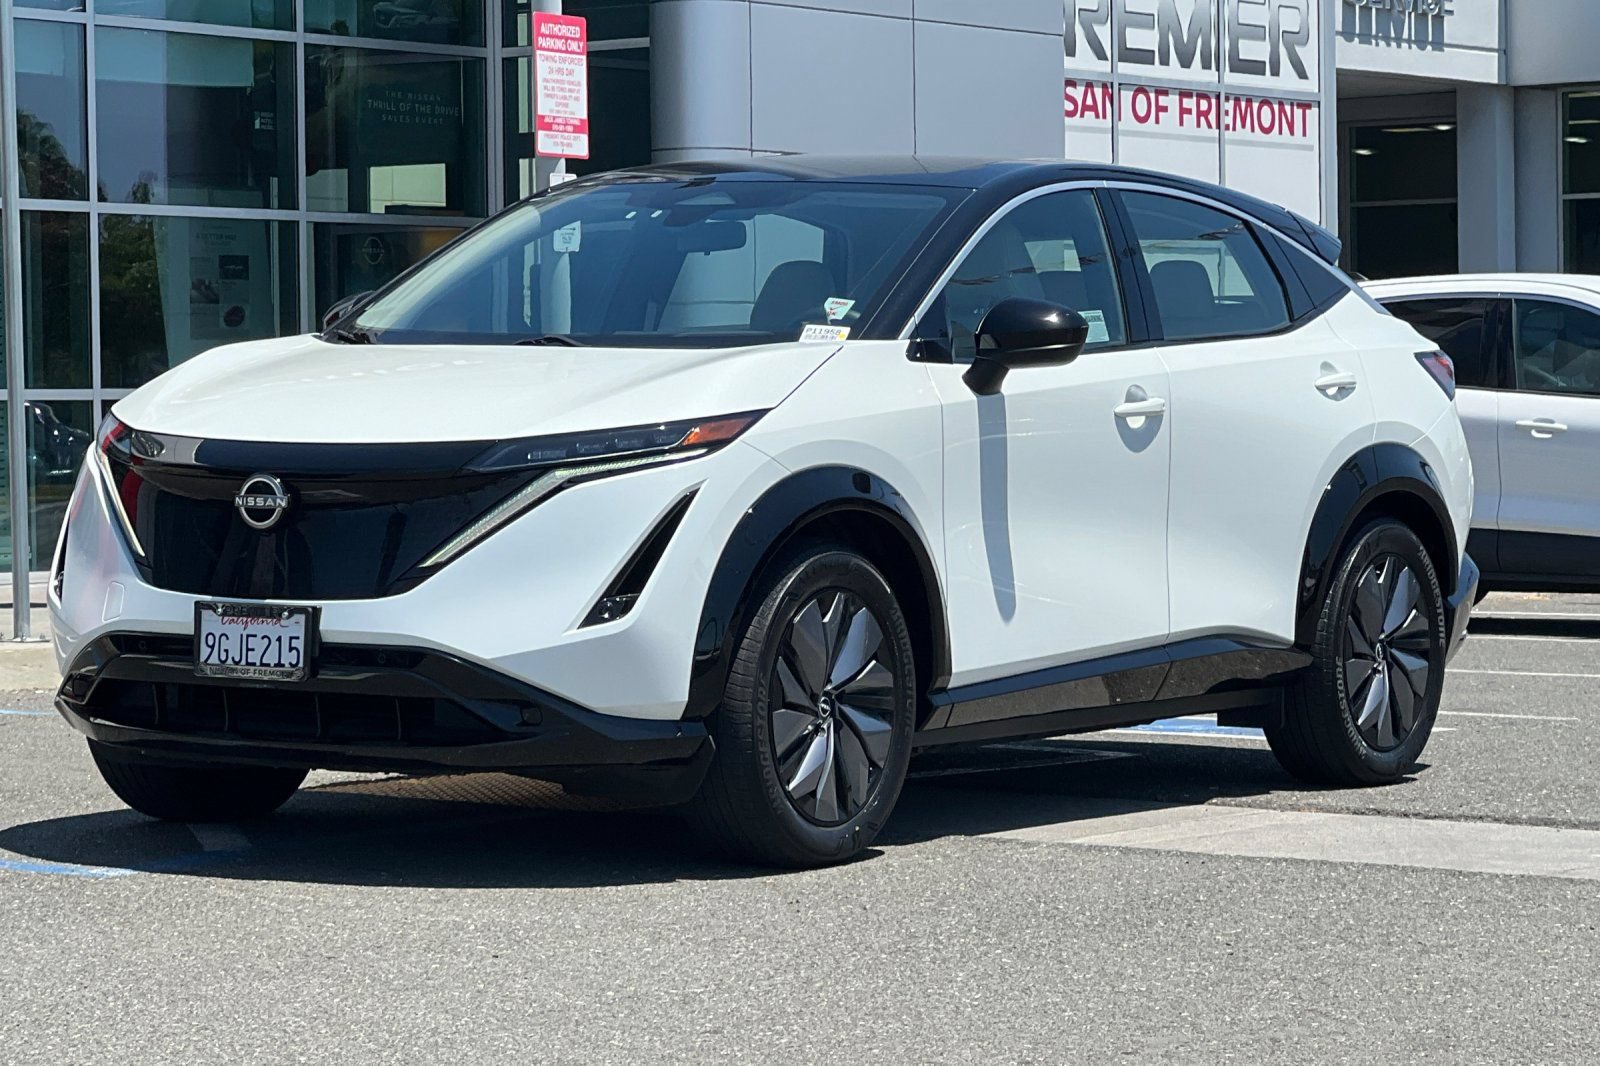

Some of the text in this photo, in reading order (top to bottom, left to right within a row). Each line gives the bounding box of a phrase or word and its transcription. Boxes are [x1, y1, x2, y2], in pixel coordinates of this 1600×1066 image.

[541, 22, 580, 38] AUTHORIZED
[538, 36, 584, 53] PARKING ONLY
[539, 53, 584, 66] TOWING ENFORCED
[367, 99, 459, 116] THRILL OF THE DRIVE
[1131, 86, 1169, 125] OF
[1178, 91, 1312, 138] FREMONT
[381, 114, 410, 123] SALES
[235, 496, 286, 507] NISSAN
[204, 632, 300, 668] 9GJE215
